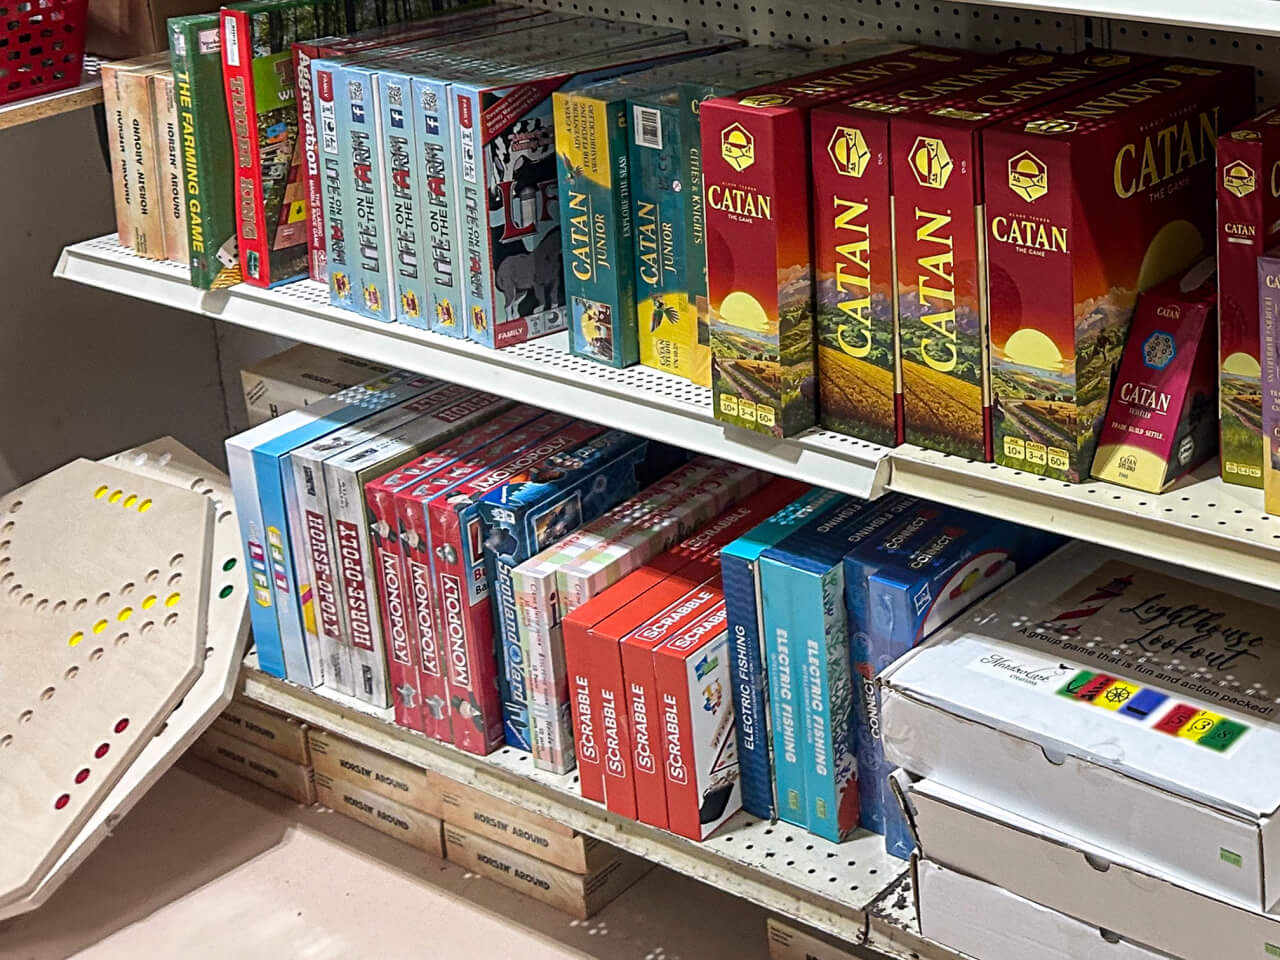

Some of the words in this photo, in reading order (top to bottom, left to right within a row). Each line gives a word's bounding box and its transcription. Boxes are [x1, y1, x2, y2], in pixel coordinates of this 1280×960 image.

[177, 71, 191, 102] THE
[297, 49, 319, 176] Aggravation
[181, 104, 200, 195] FARMING
[229, 76, 252, 169] TIMBER
[1114, 106, 1220, 200] CATAN
[350, 130, 373, 192] FARM
[690, 148, 701, 185] CITIES
[189, 198, 205, 254] GAME
[239, 176, 258, 241] KING
[357, 197, 366, 218] ON
[365, 196, 375, 222] THE
[691, 193, 703, 245] KNIGHTS
[708, 185, 772, 220] CATAN
[991, 215, 1069, 253] CATAN
[1225, 223, 1256, 237] CATAN
[355, 222, 380, 273] LIFE
[570, 191, 593, 282] CATAN
[593, 213, 611, 271] JUNIOR
[639, 200, 659, 286] CATAN
[663, 221, 675, 272] JUNIOR
[834, 195, 871, 359] CATAN
[915, 208, 957, 373] CATAN
[1120, 382, 1171, 412] CATAN
[307, 510, 342, 638] HORSE-OPOLY
[338, 520, 373, 651] HORSE-OPOLY
[385, 554, 411, 665] MONOPOLY
[411, 562, 439, 676] MONOPOLY
[443, 575, 469, 687] MONOPOLY
[498, 563, 519, 643] Scotland
[510, 667, 527, 704] Yard
[645, 590, 713, 640] SCRABBLE
[1119, 592, 1264, 648] Lighthouse
[735, 624, 750, 682] FISHING
[776, 628, 793, 700] ELECTRIC
[807, 640, 824, 712] ELECTRIC
[1027, 629, 1062, 647] group
[1063, 641, 1096, 657] game
[1096, 650, 1119, 666] that
[1120, 658, 1132, 670] is
[1134, 660, 1156, 676] fun
[1156, 668, 1179, 684] and
[1180, 675, 1219, 697] action
[1219, 687, 1275, 716] packed!
[1124, 624, 1261, 672] Lookout
[577, 675, 597, 762] SCRABBLE
[603, 689, 622, 774] SCRABBLE
[632, 683, 652, 770] SCRABBLE
[664, 694, 685, 781] SCRABBLE
[737, 684, 756, 751] ELECTRIC
[782, 700, 797, 764] FISHING
[868, 676, 882, 740] CONNECT
[813, 711, 828, 778] FISHING
[473, 811, 509, 833] HORSIN'
[511, 826, 549, 849] AROUND
